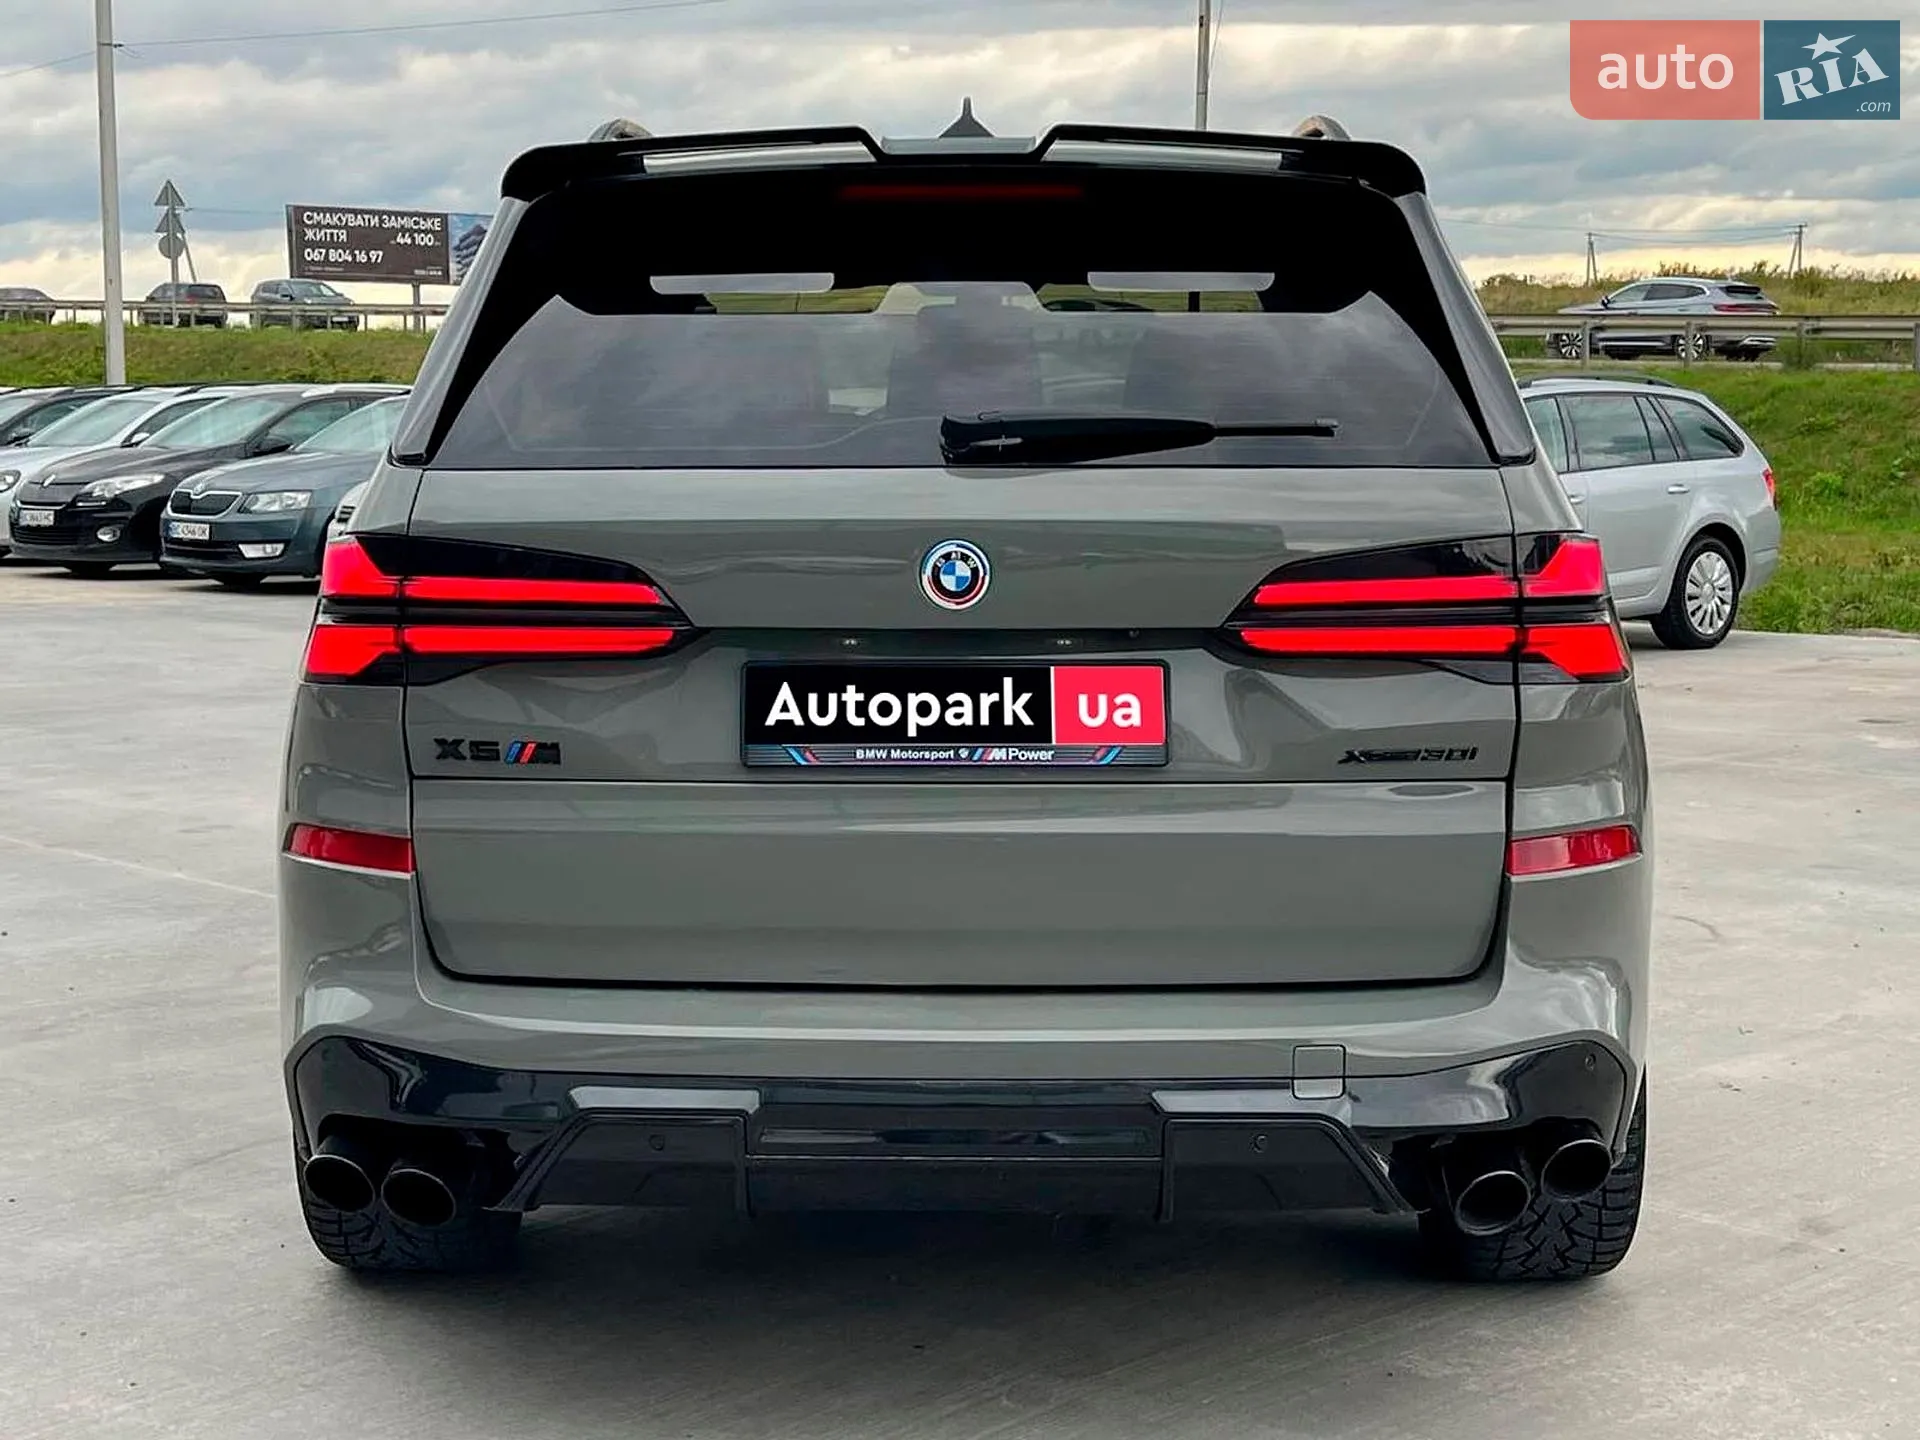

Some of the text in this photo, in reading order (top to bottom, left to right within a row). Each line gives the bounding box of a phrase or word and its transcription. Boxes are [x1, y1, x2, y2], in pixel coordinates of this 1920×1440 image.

[303, 211, 441, 230] СМАКУВАТИ ЗАМІСЬКЕ
[303, 228, 347, 242] ЖИТТЯ
[396, 232, 434, 246] 44 100
[304, 248, 383, 263] 067 804 16 97
[764, 677, 1142, 737] Autopark ua
[433, 738, 500, 761] X5
[856, 749, 888, 760] BMW
[891, 748, 955, 761] Motorsport
